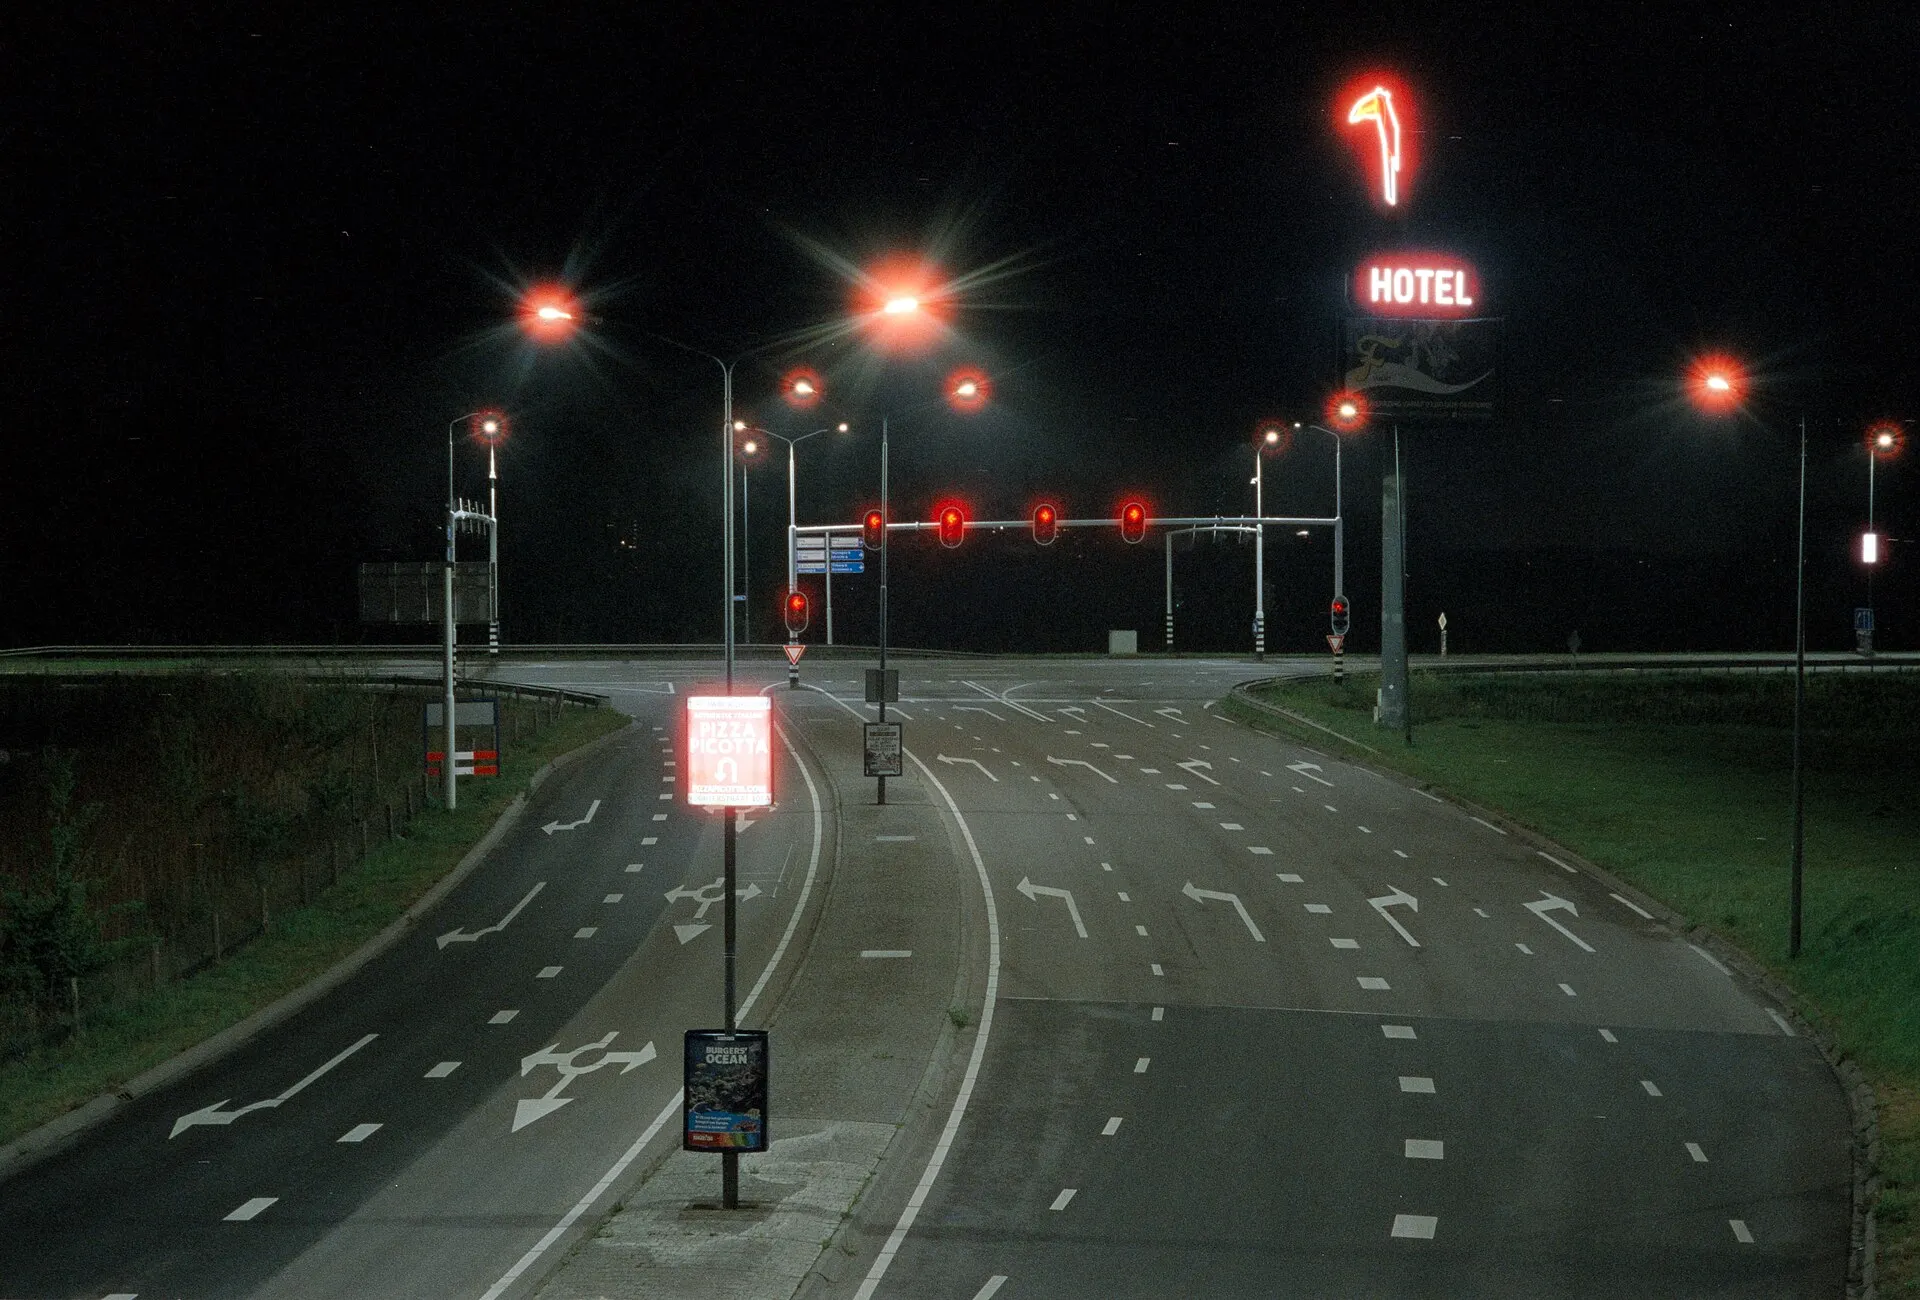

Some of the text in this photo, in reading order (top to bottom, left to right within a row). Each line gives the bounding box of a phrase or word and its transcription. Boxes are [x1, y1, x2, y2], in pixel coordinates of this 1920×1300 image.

[1371, 267, 1473, 306] HOTEL
[699, 721, 756, 738] PIZZA
[690, 738, 768, 754] PICOTTA
[706, 1046, 748, 1054] BURGERS'
[705, 1054, 748, 1064] OCEAN
